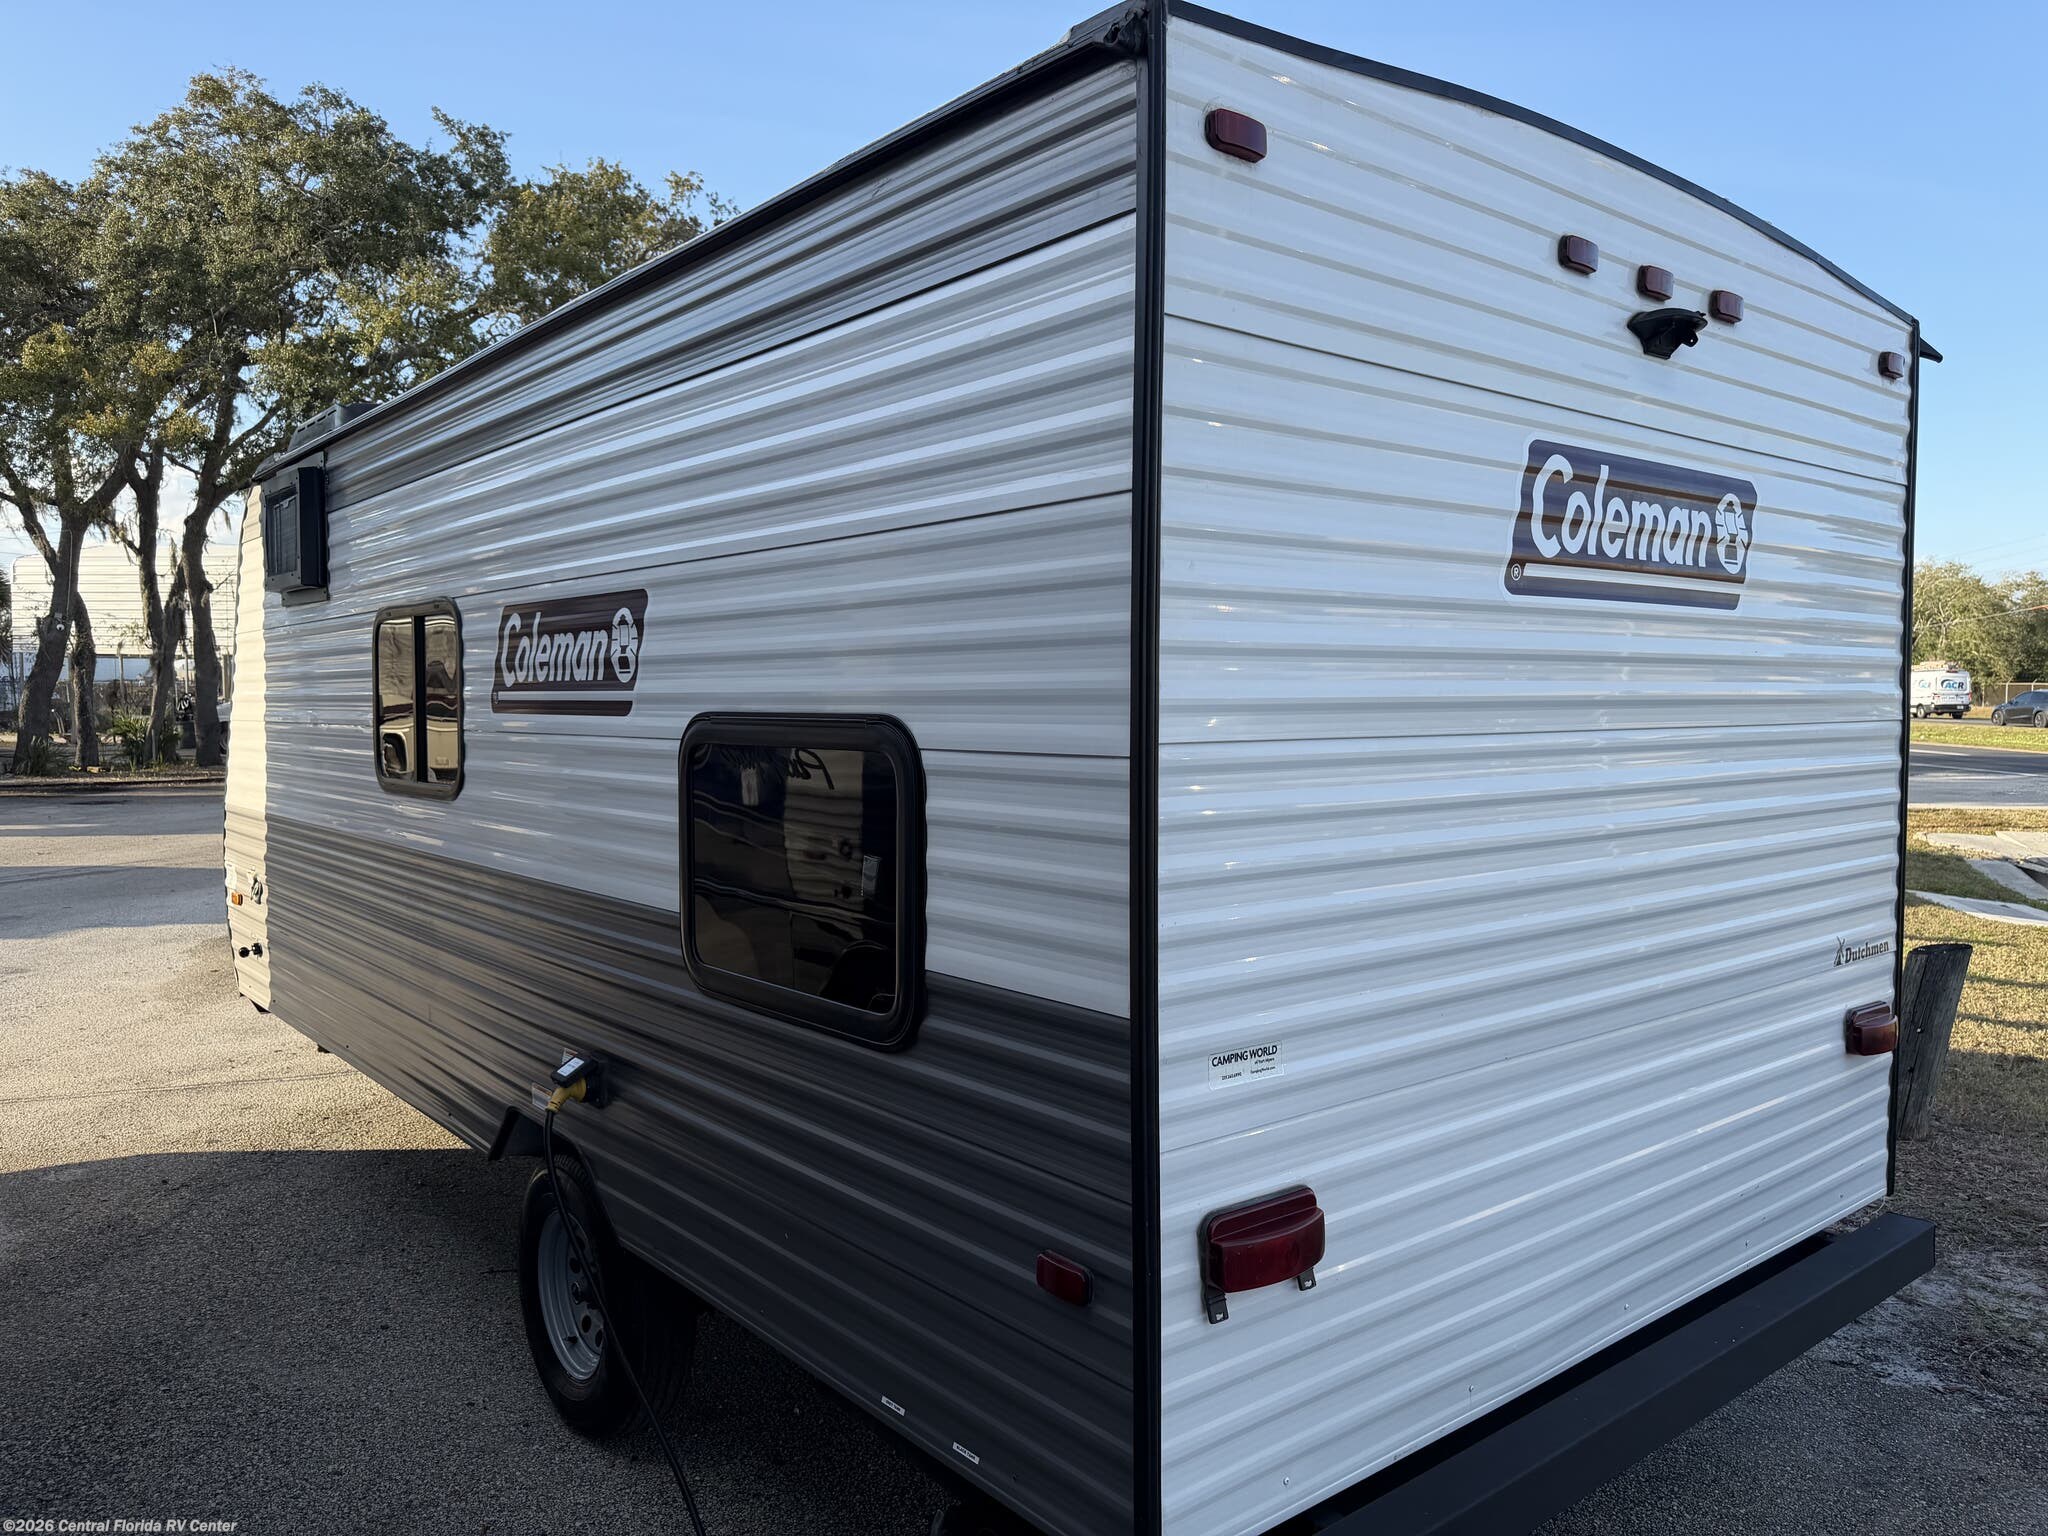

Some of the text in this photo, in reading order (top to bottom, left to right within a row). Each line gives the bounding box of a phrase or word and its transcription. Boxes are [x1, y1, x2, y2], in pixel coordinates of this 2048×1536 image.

[1530, 454, 1713, 568] Coleman
[500, 611, 609, 688] Coleman
[1944, 680, 1965, 689] ACR
[1844, 940, 1889, 963] Dutchmen
[1211, 1045, 1278, 1067] CAMPING WORLD
